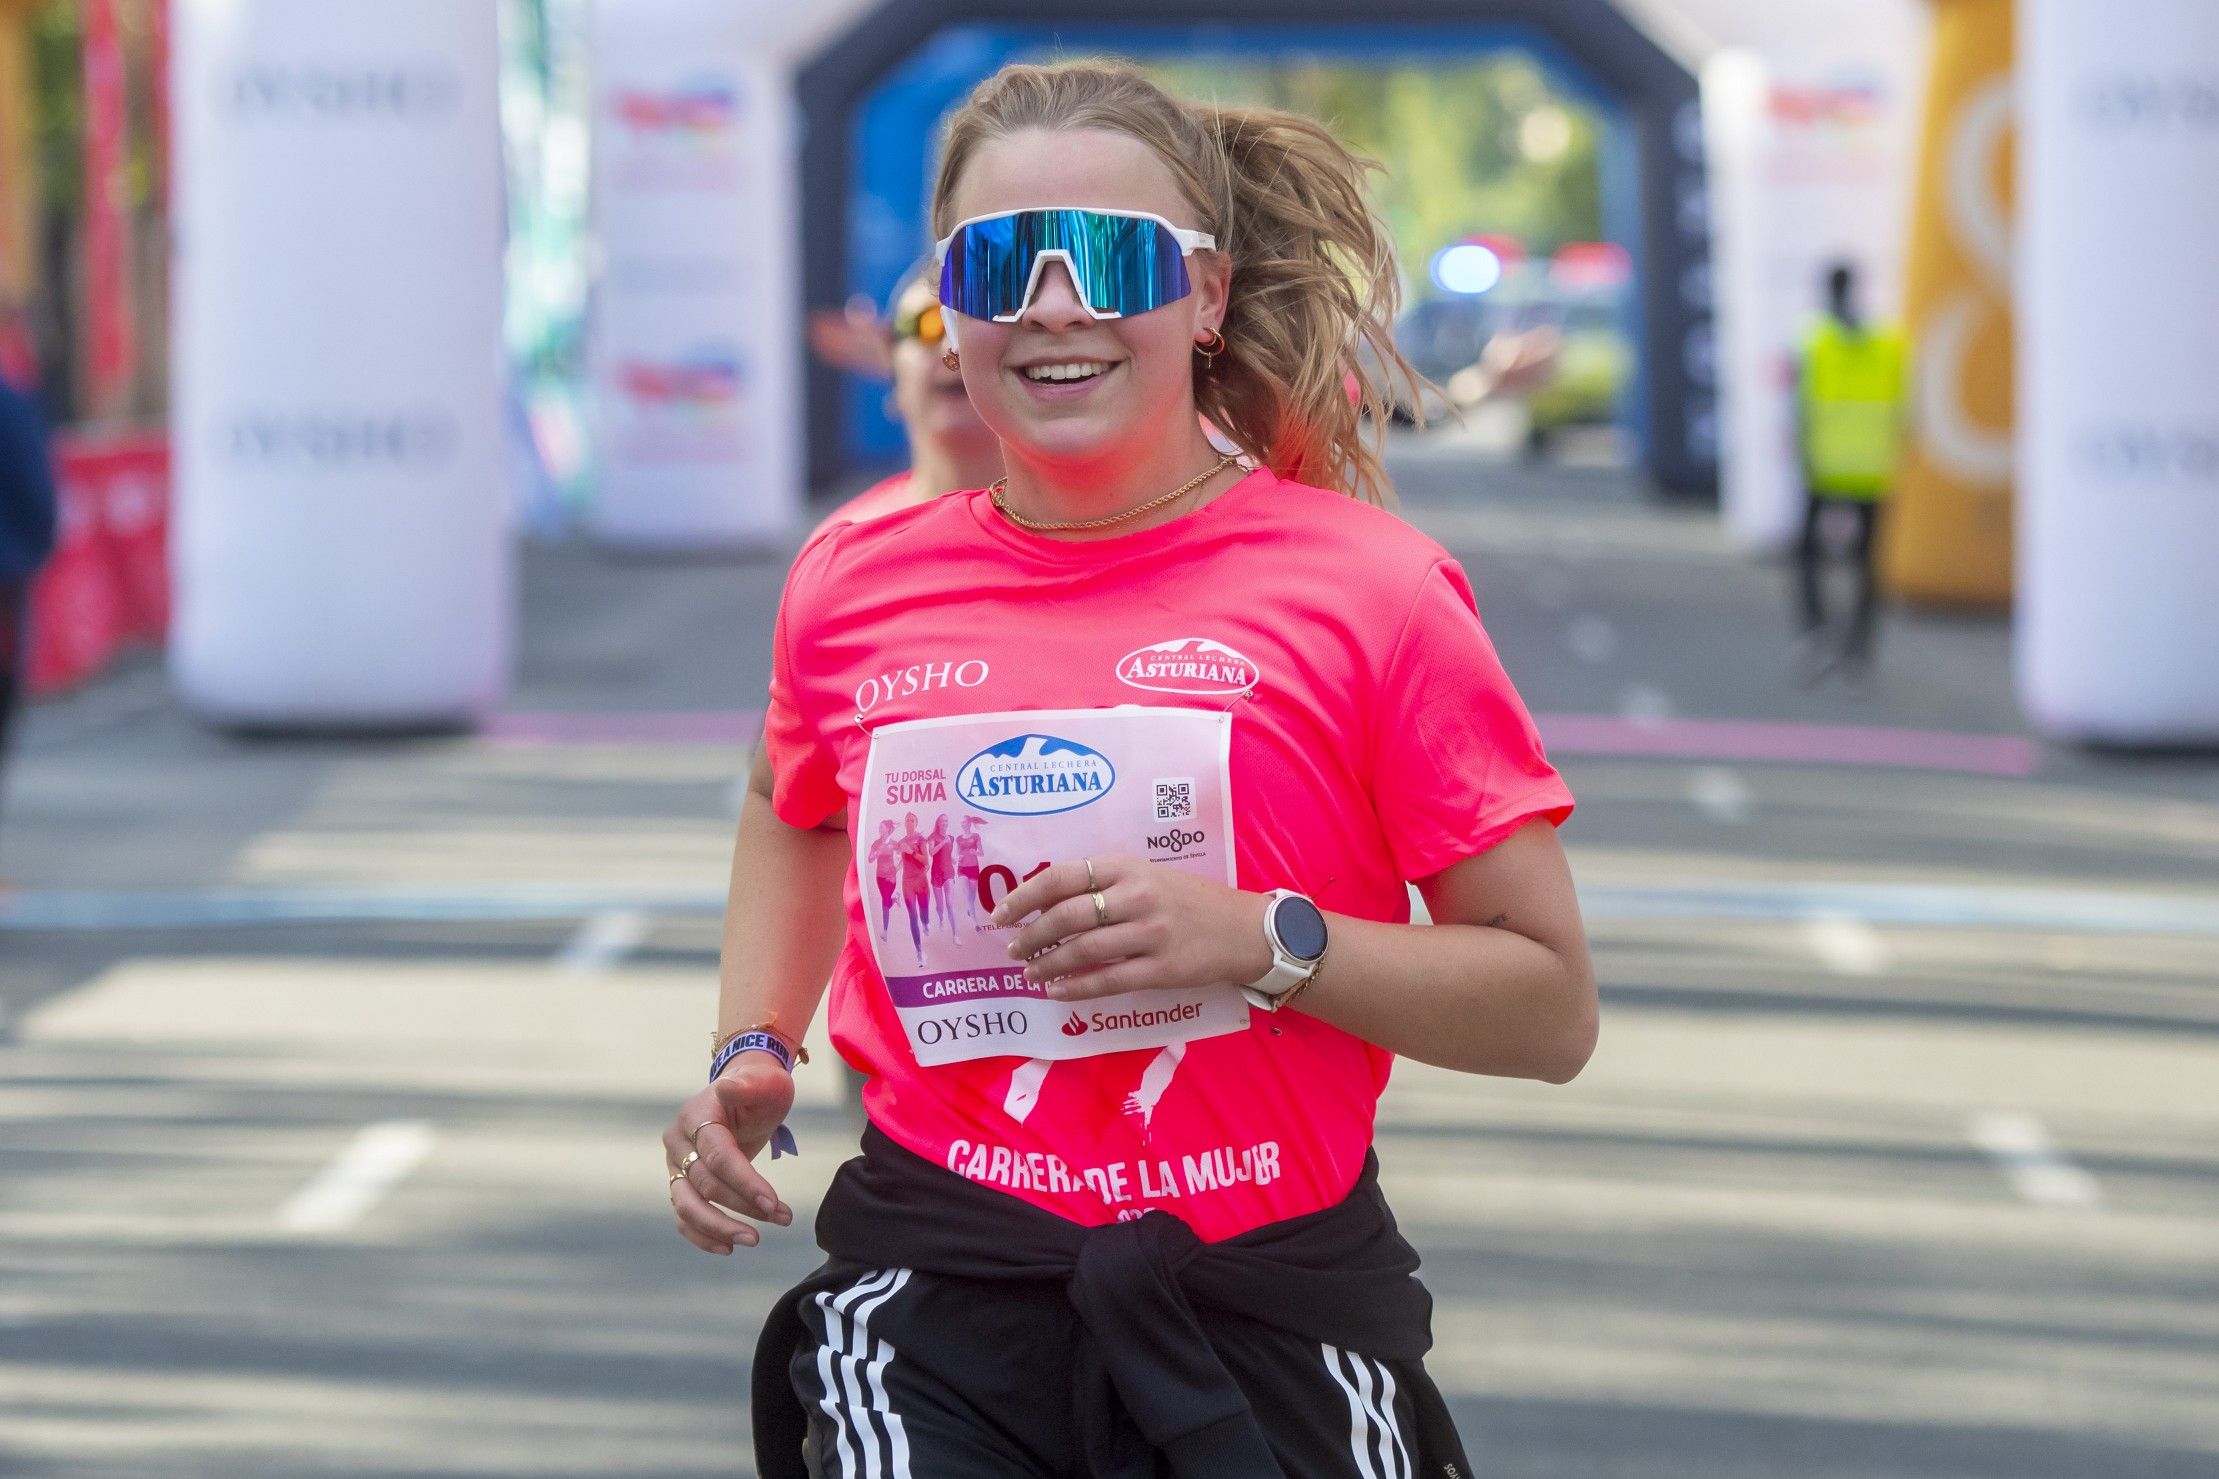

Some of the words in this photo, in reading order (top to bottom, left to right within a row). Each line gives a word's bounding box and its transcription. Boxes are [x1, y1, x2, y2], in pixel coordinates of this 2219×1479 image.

[855, 660, 989, 713] OYSHO
[1126, 657, 1247, 686] ASTURIANA
[885, 772, 899, 784] TU
[902, 768, 946, 782] DORSAL
[990, 762, 1038, 772] CENTRAL
[1044, 759, 1097, 769] LECHERA
[886, 782, 947, 805] SUMA
[967, 767, 1103, 798] ASTURIANA
[977, 861, 1051, 914] 0
[922, 975, 999, 998] CARRERA
[1002, 974, 1024, 991] DE
[917, 1010, 1028, 1045] OYSHO
[1091, 1002, 1203, 1033] Santander
[732, 1034, 765, 1053] NICE
[766, 1036, 790, 1065] RUN
[1137, 1159, 1181, 1198] LA
